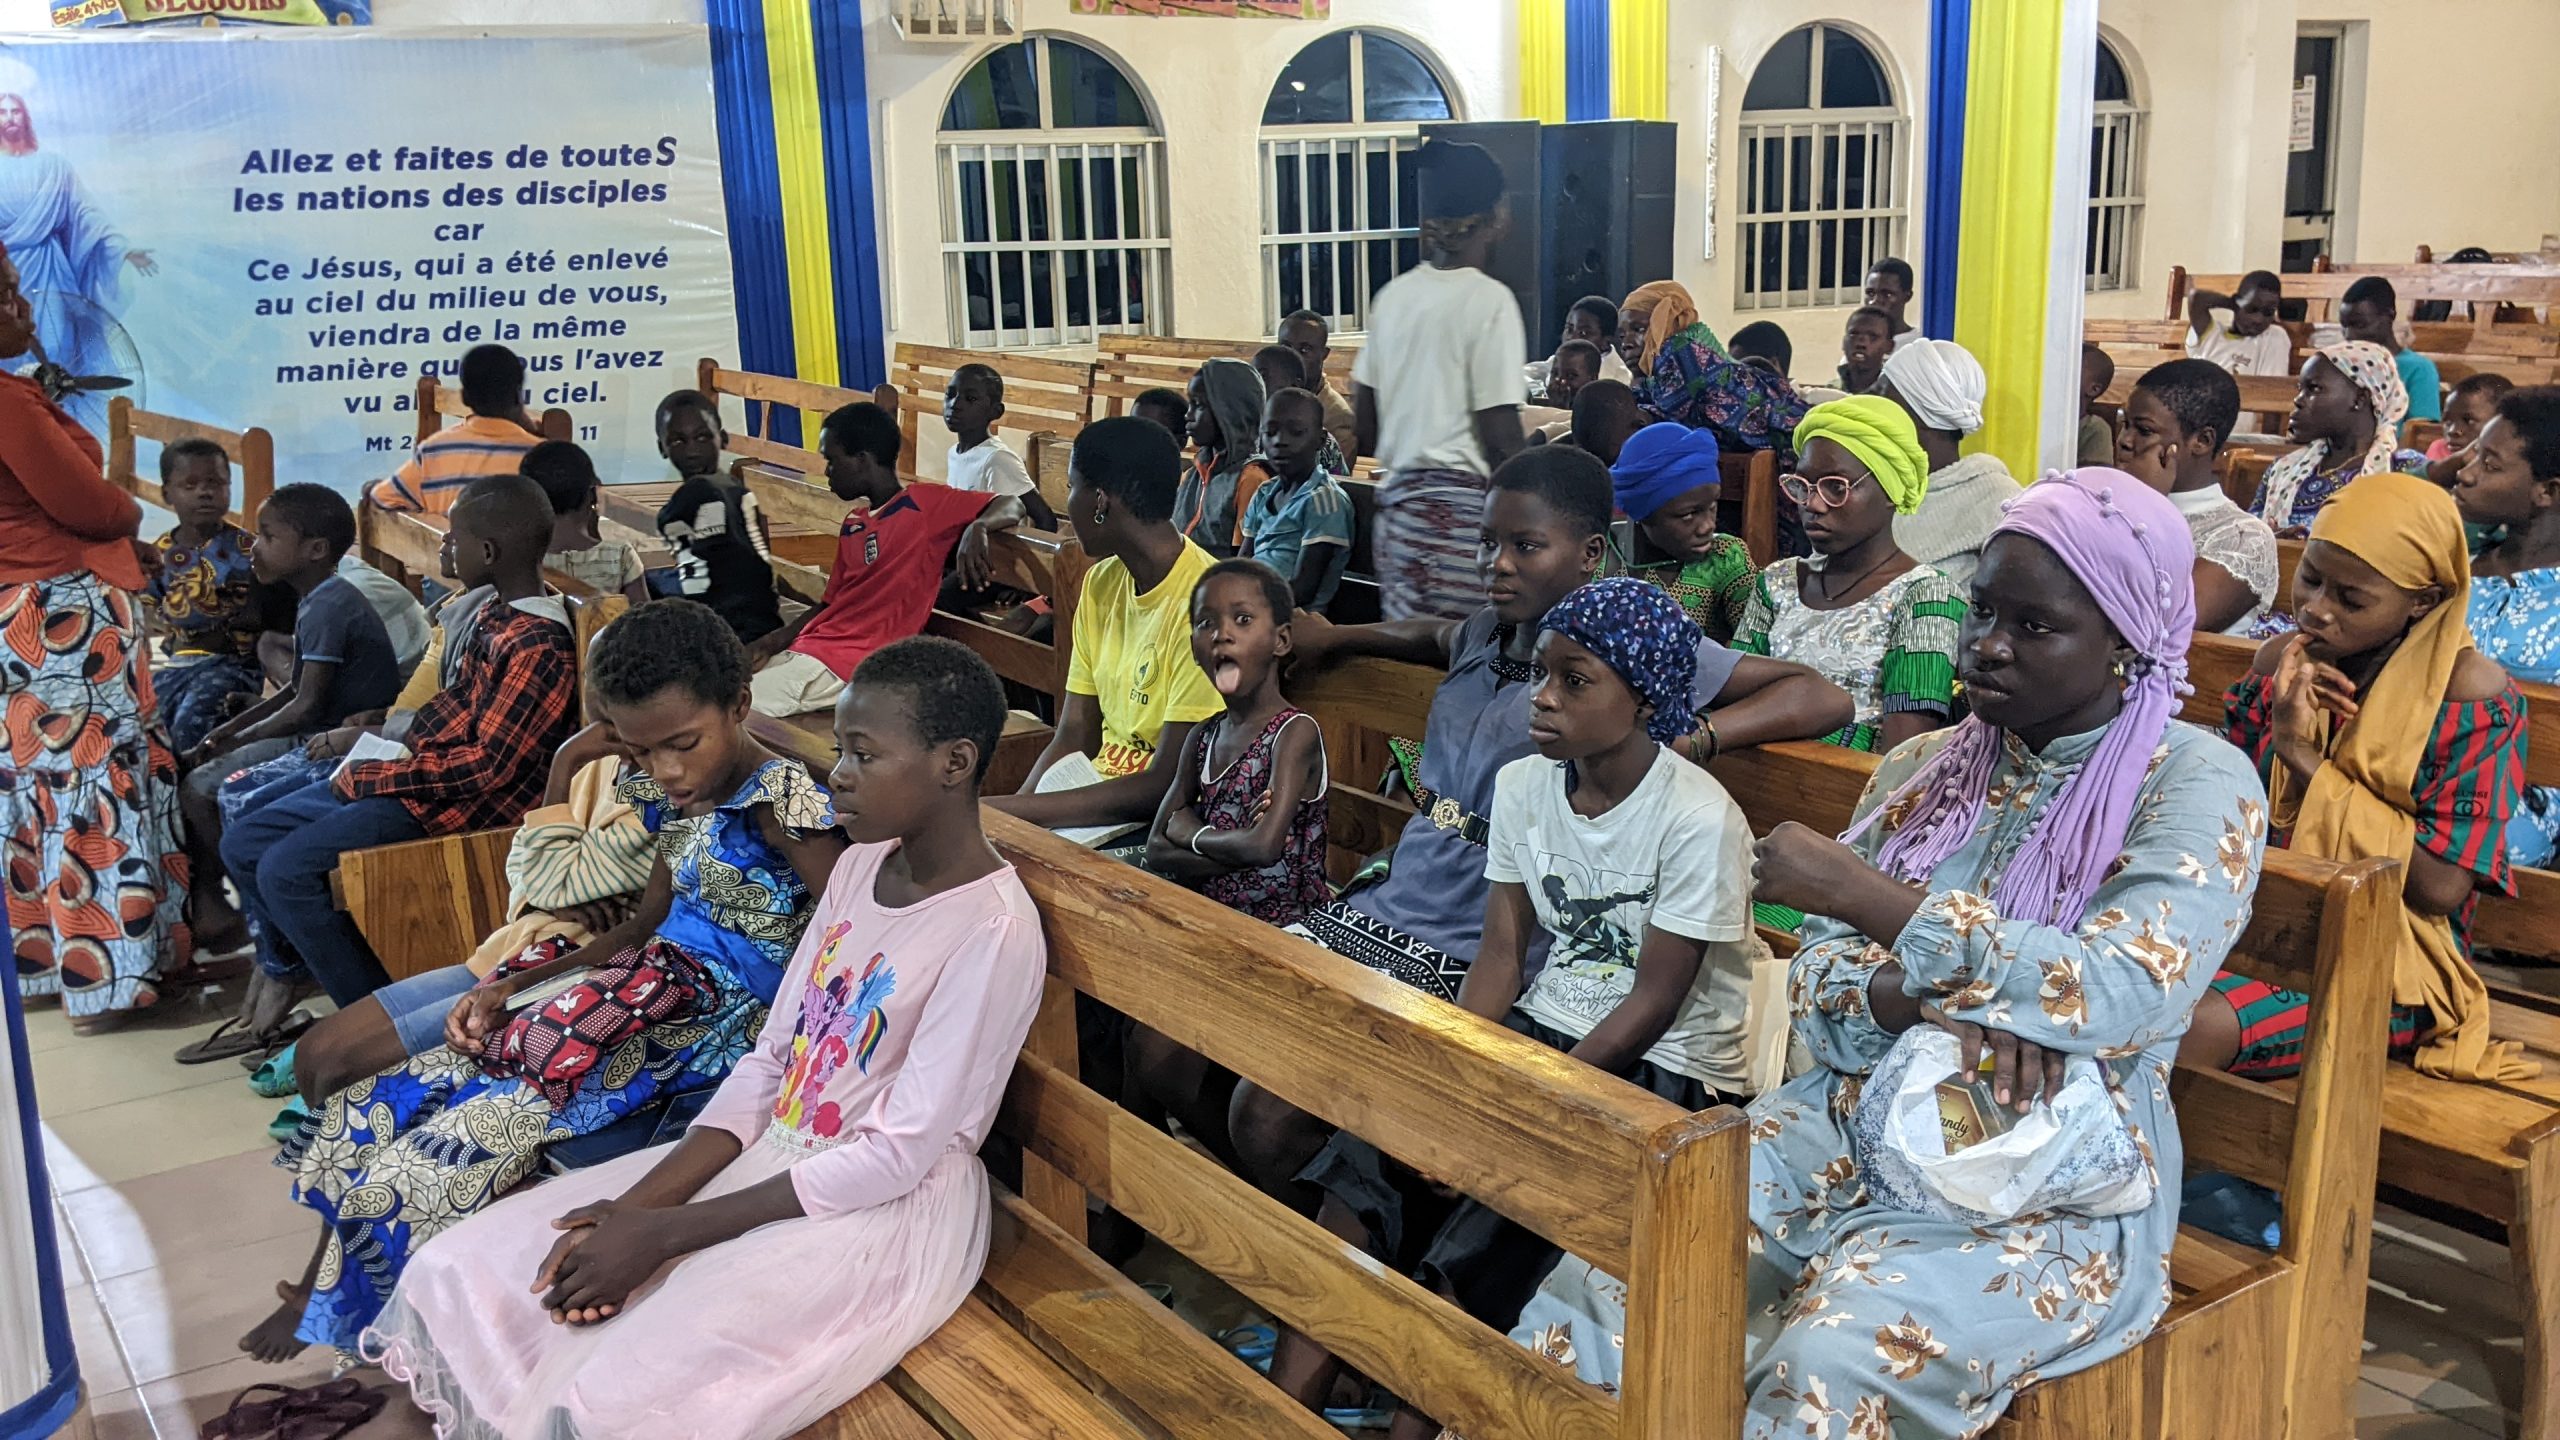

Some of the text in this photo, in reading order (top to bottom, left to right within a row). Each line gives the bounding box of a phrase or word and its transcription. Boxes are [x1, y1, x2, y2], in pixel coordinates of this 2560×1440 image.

[241, 137, 676, 174] Allez et faites de touteS
[234, 179, 667, 212] les nations des disciples
[434, 224, 485, 242] car
[248, 246, 669, 281] Ce Jésus, qui a été enlevé
[256, 284, 667, 316] au ciel du milieu de vous,
[309, 315, 627, 348] viendra de la même
[277, 357, 408, 384] manière
[344, 396, 381, 414] vu
[543, 381, 607, 404] ciel.
[366, 437, 393, 452] Mt
[1939, 1108, 1969, 1138] andy
